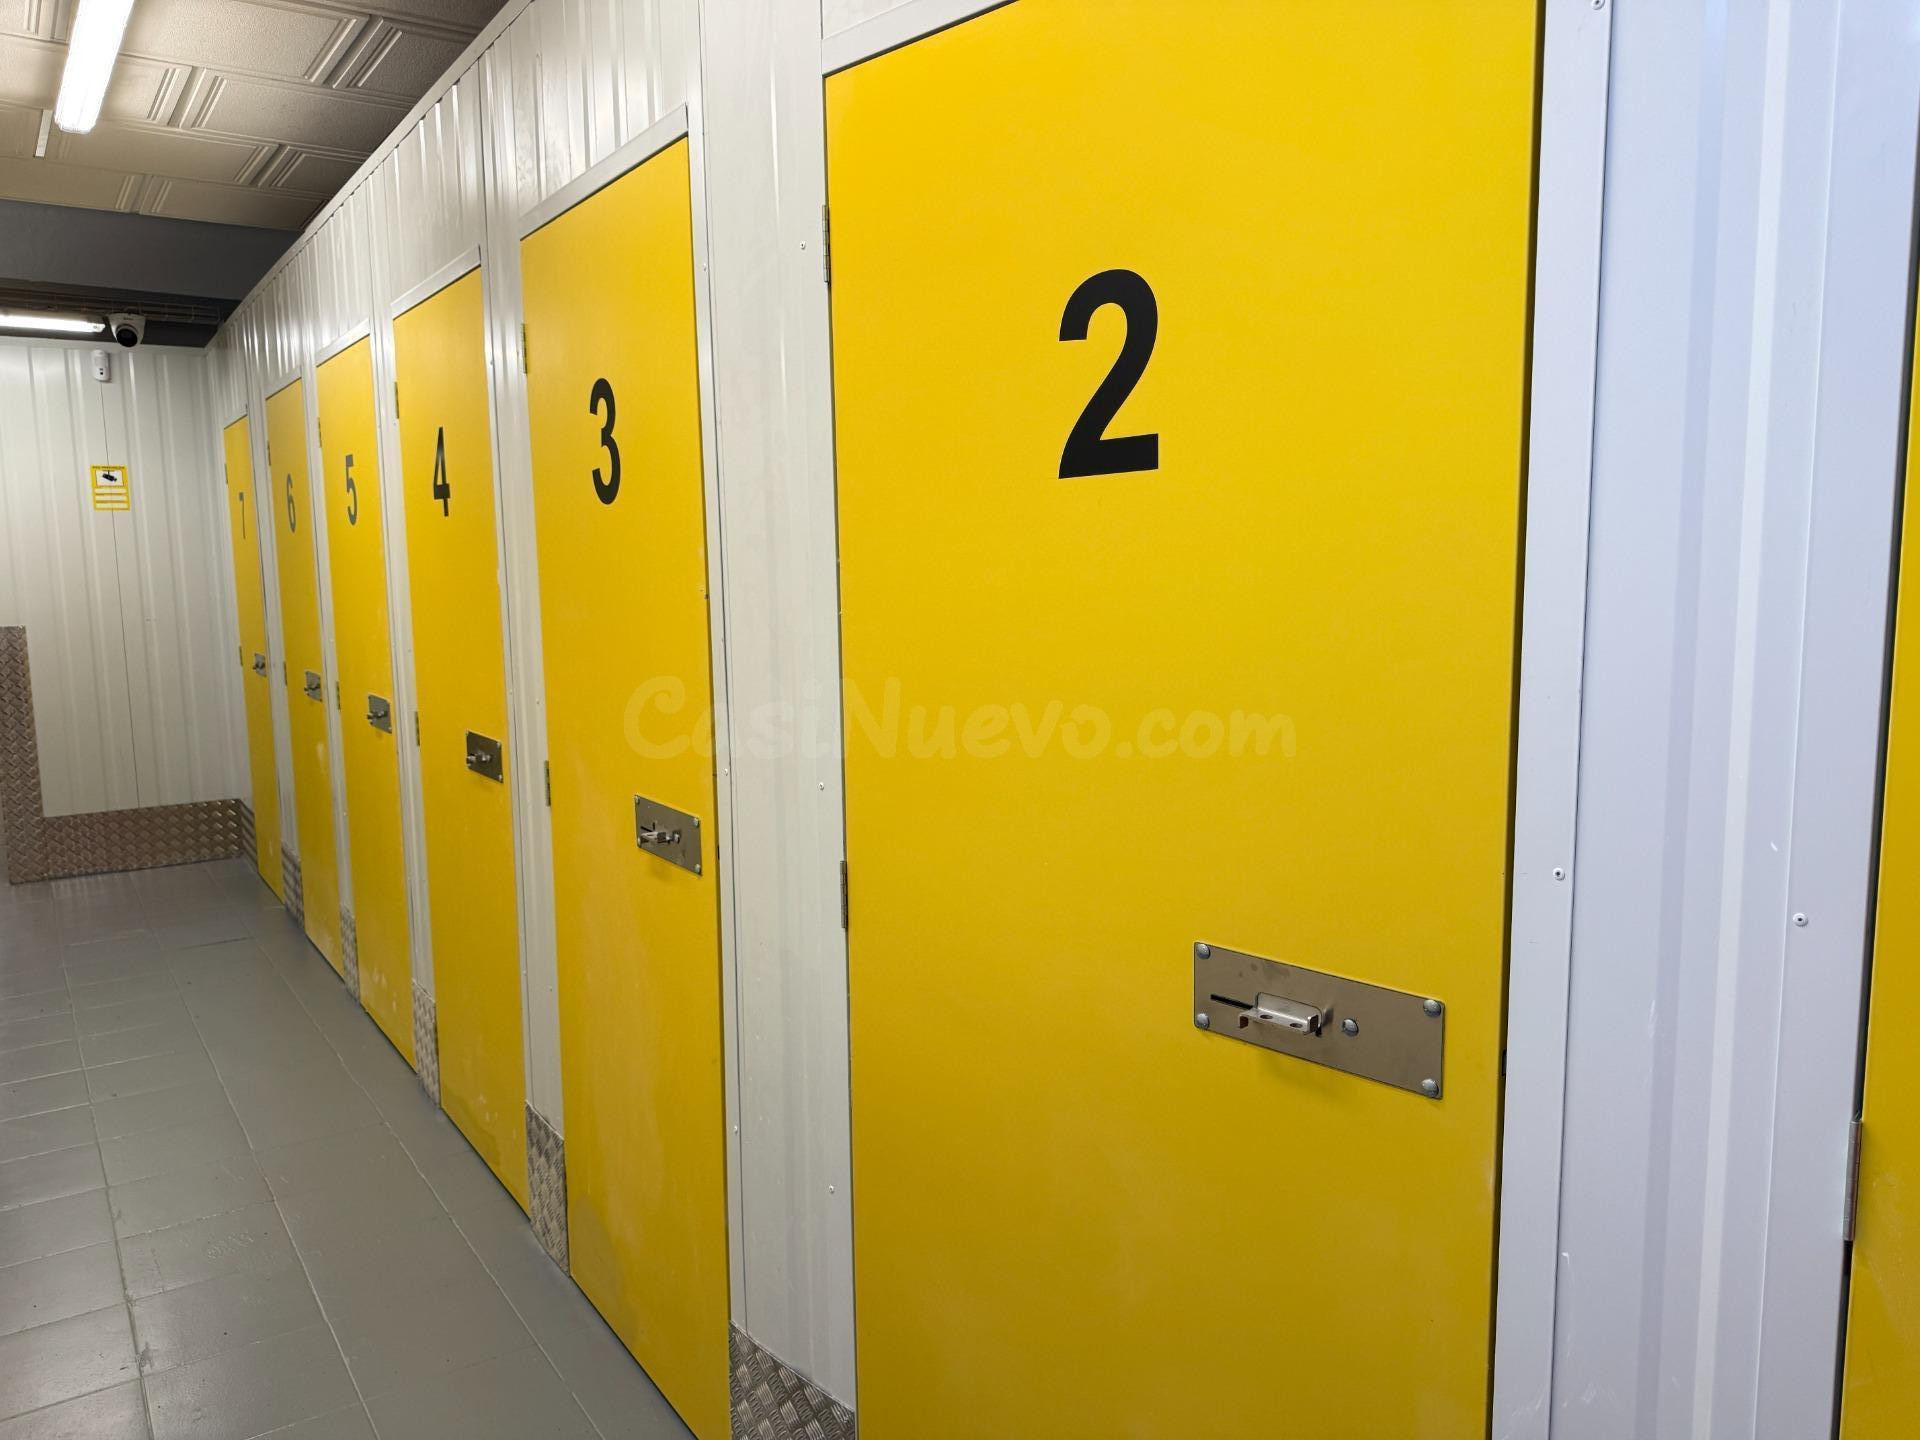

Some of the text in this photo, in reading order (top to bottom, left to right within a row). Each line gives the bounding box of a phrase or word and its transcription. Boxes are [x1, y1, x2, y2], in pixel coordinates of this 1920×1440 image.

[1058, 268, 1159, 480] 2
[432, 427, 451, 517] 4
[589, 377, 622, 505] 3
[239, 492, 246, 540] 7
[286, 474, 297, 533] 6
[345, 454, 358, 525] 5
